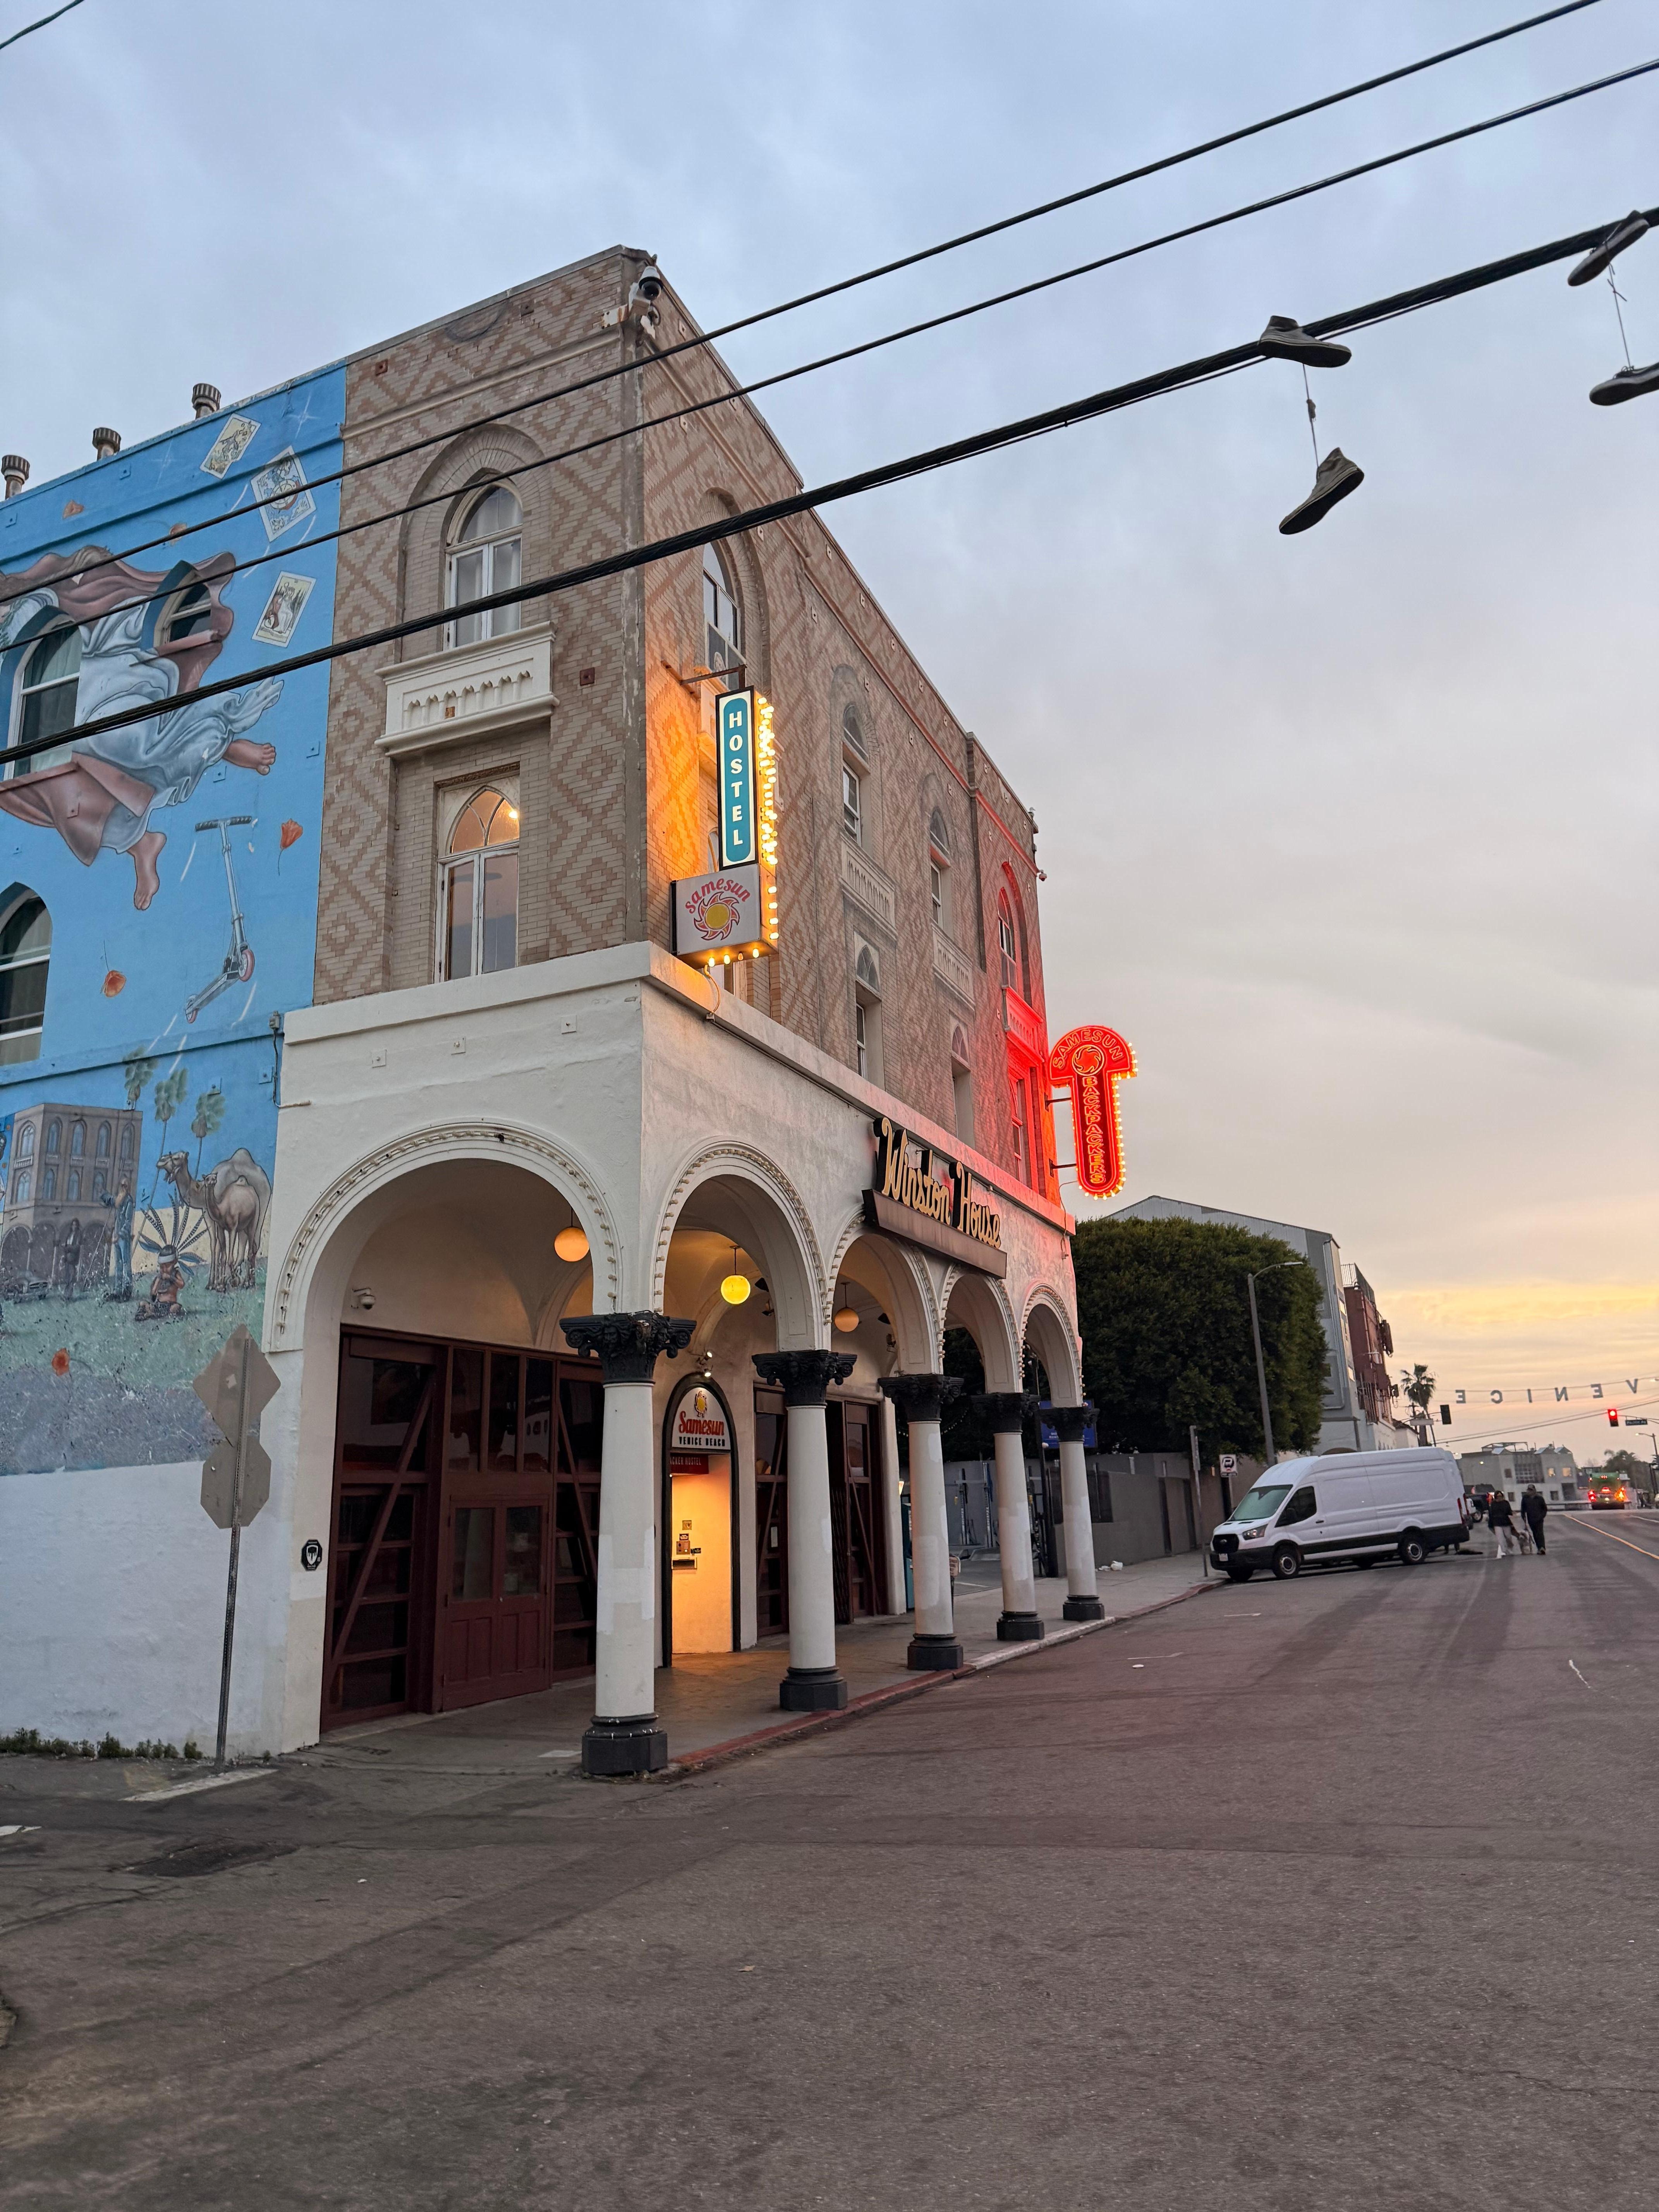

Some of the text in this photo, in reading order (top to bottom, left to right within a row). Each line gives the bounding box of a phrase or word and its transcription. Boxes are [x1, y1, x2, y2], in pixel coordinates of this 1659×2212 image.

[728, 711, 743, 846] HOSTEL
[685, 877, 751, 914] samesun
[1052, 1029, 1124, 1070] SAMESUN
[1082, 1076, 1107, 1184] BACKPACKERS
[879, 1116, 1001, 1249] Winston House
[678, 1410, 725, 1436] Samesun
[679, 1436, 725, 1446] VENICE BEACH
[685, 1457, 701, 1465] HOSTEL
